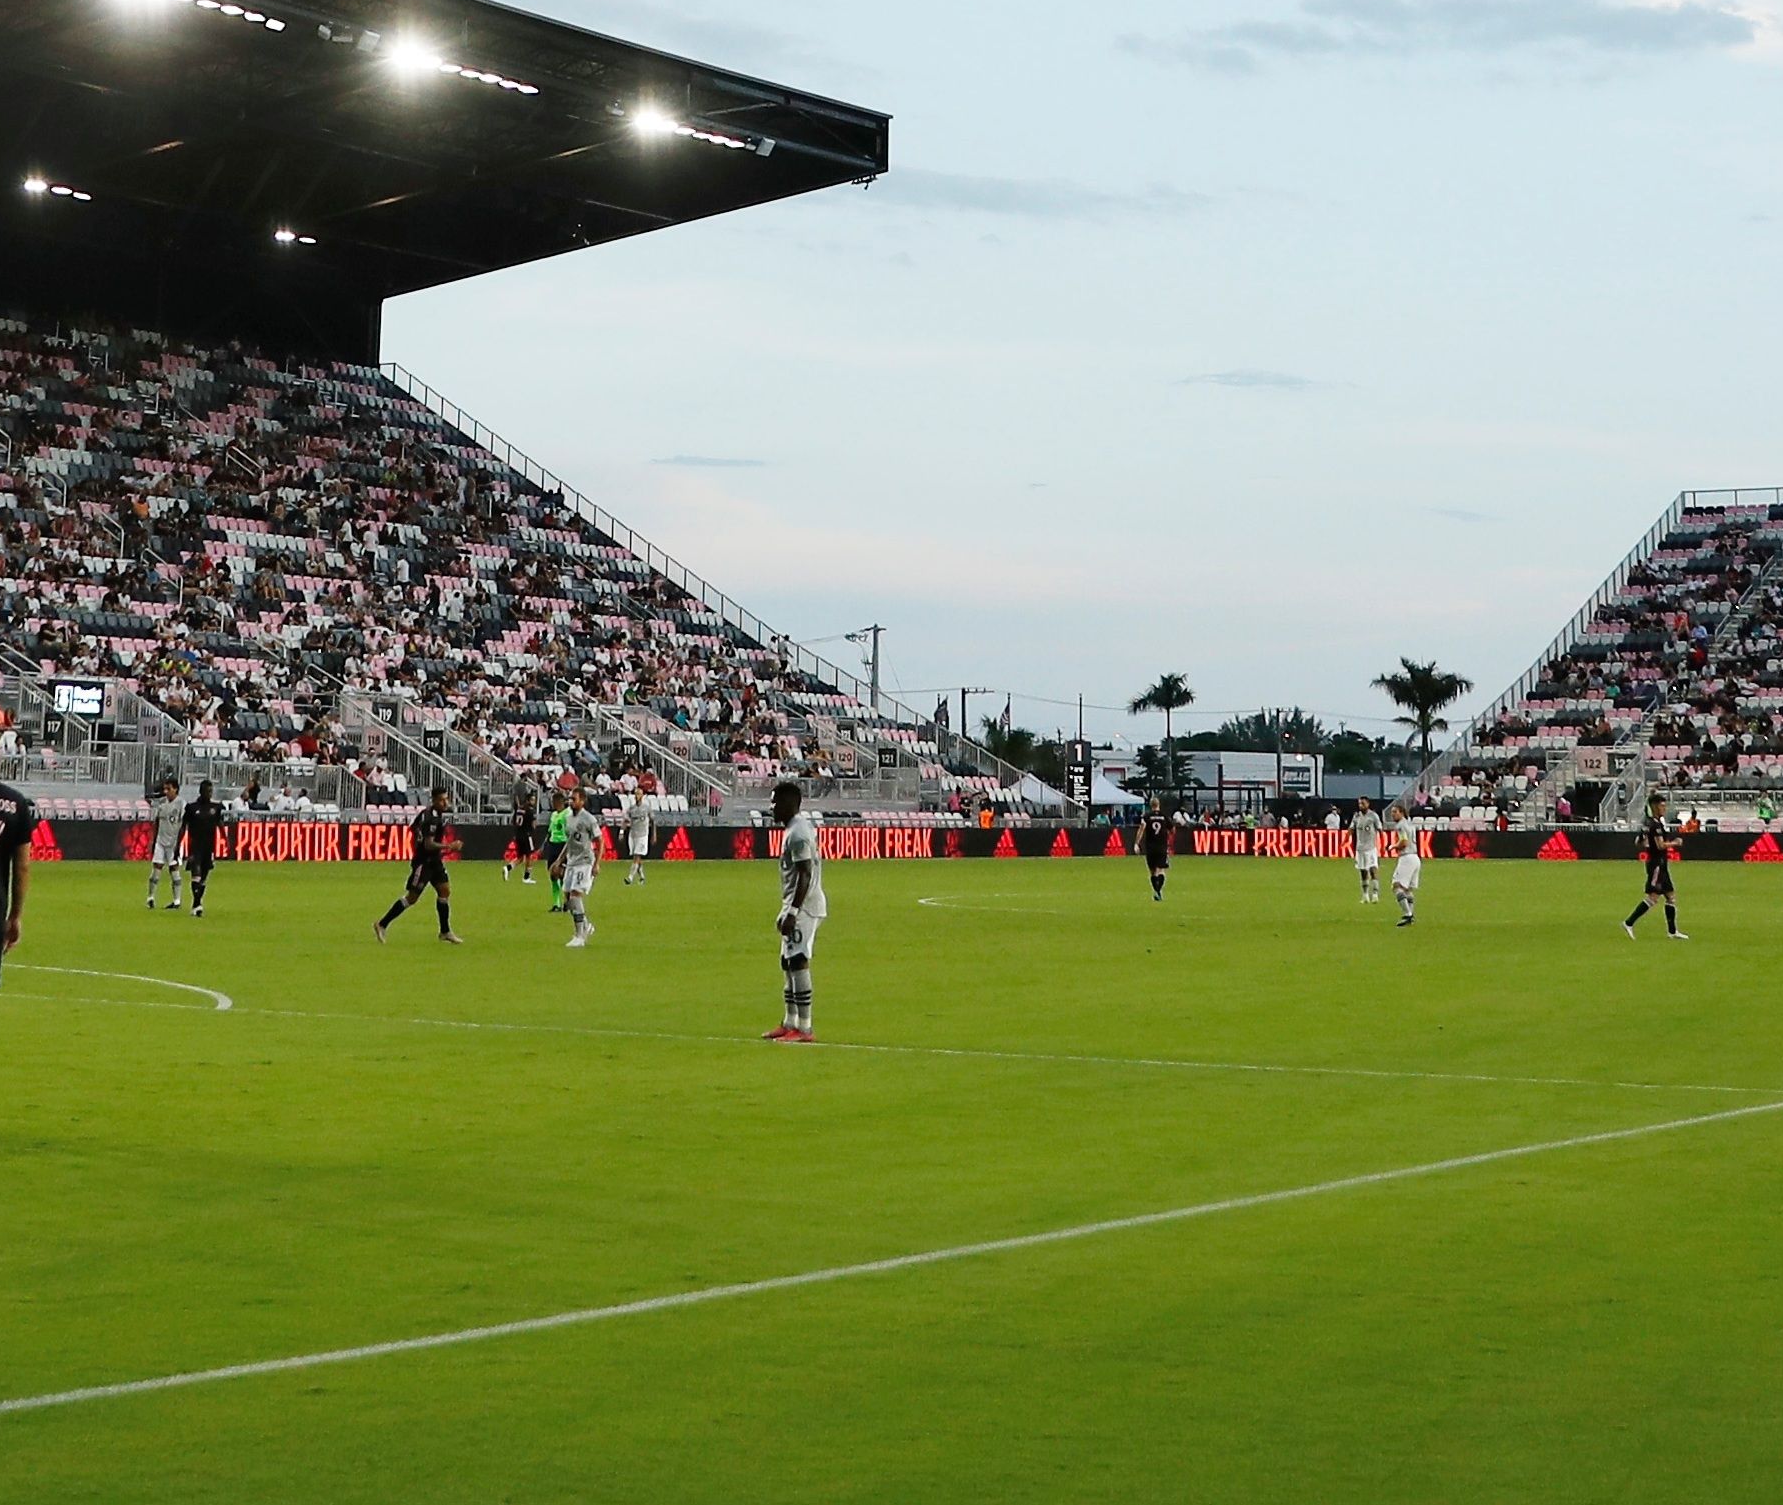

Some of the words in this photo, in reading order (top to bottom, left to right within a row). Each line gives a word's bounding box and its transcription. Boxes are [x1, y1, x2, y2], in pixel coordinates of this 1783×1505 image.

[378, 707, 392, 721] 119
[47, 720, 61, 732] 117
[426, 737, 440, 748] 119
[673, 746, 687, 756] 120
[1074, 743, 1083, 762] 1
[881, 754, 894, 763] 121
[1583, 759, 1602, 769] 122
[1151, 824, 1162, 836] 9
[235, 821, 341, 861] PREDATOR
[348, 824, 415, 860] FREAK
[819, 828, 881, 859] REDATOR
[884, 828, 933, 858] FREAK
[1193, 830, 1245, 854] WITH
[1252, 828, 1355, 858] PREDATOR
